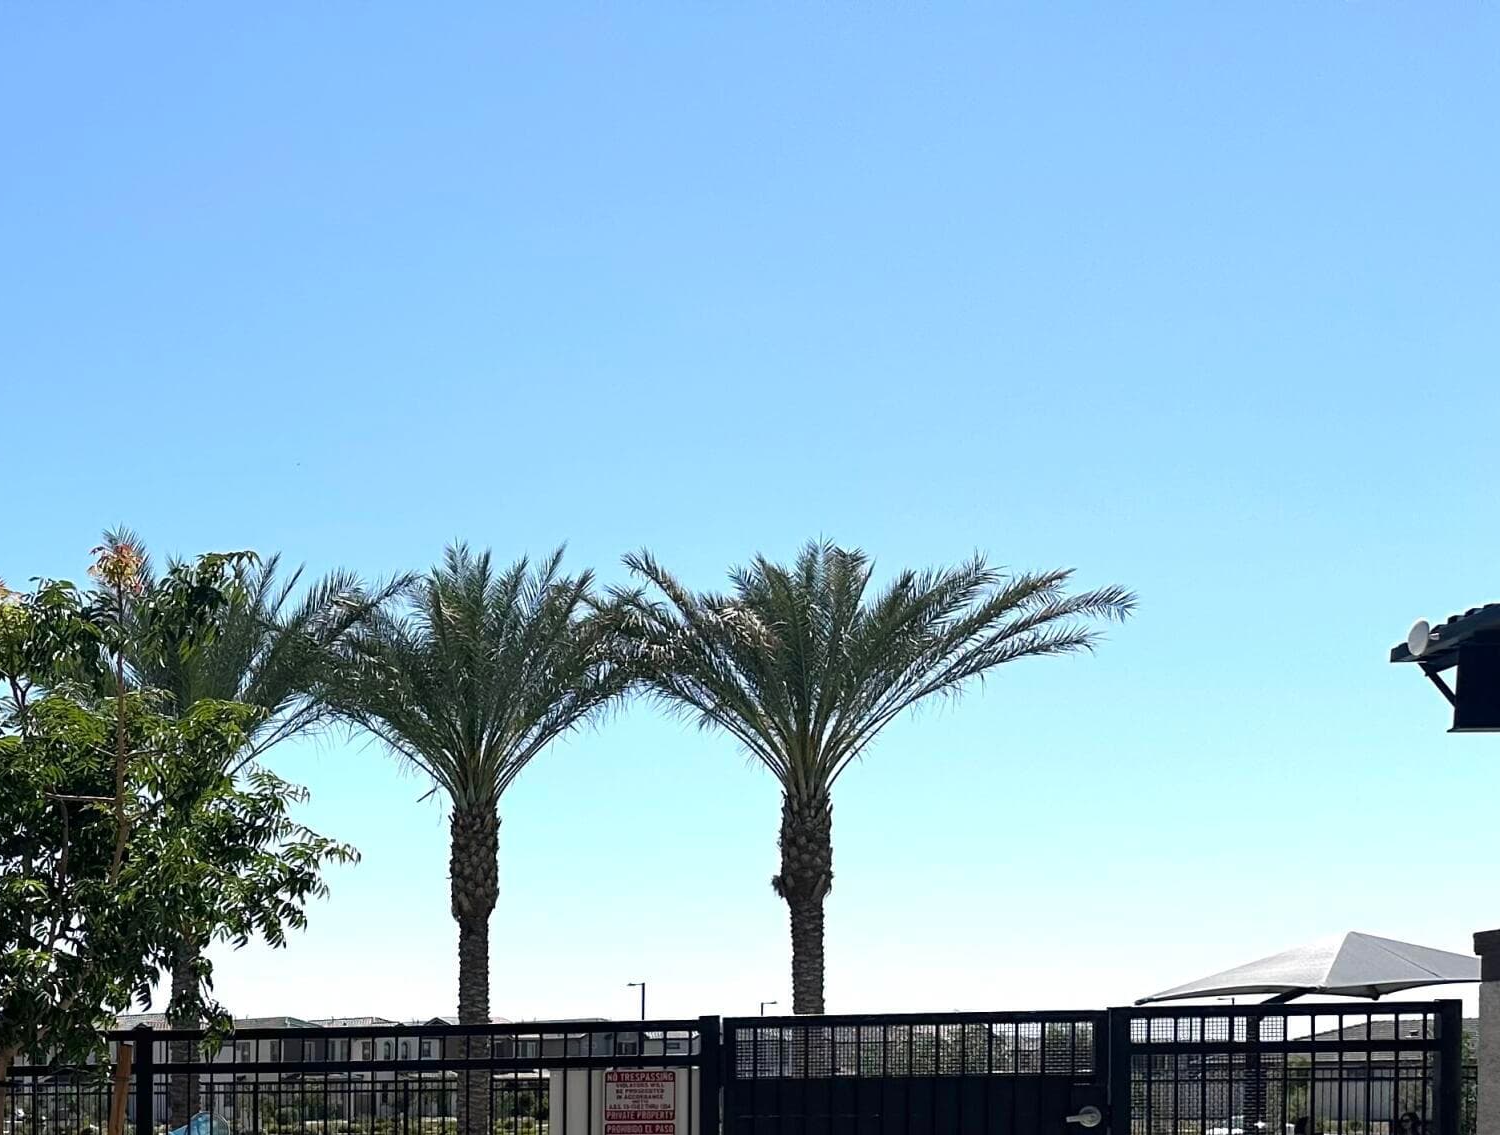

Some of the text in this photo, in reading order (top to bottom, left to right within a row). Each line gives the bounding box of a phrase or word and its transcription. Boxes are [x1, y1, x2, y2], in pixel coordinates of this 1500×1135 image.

[607, 1072, 674, 1081] NO TRESPASSING
[607, 1111, 674, 1120] PRIVATE PROPERTY
[607, 1125, 674, 1133] PROHIBIDO EL PASO
